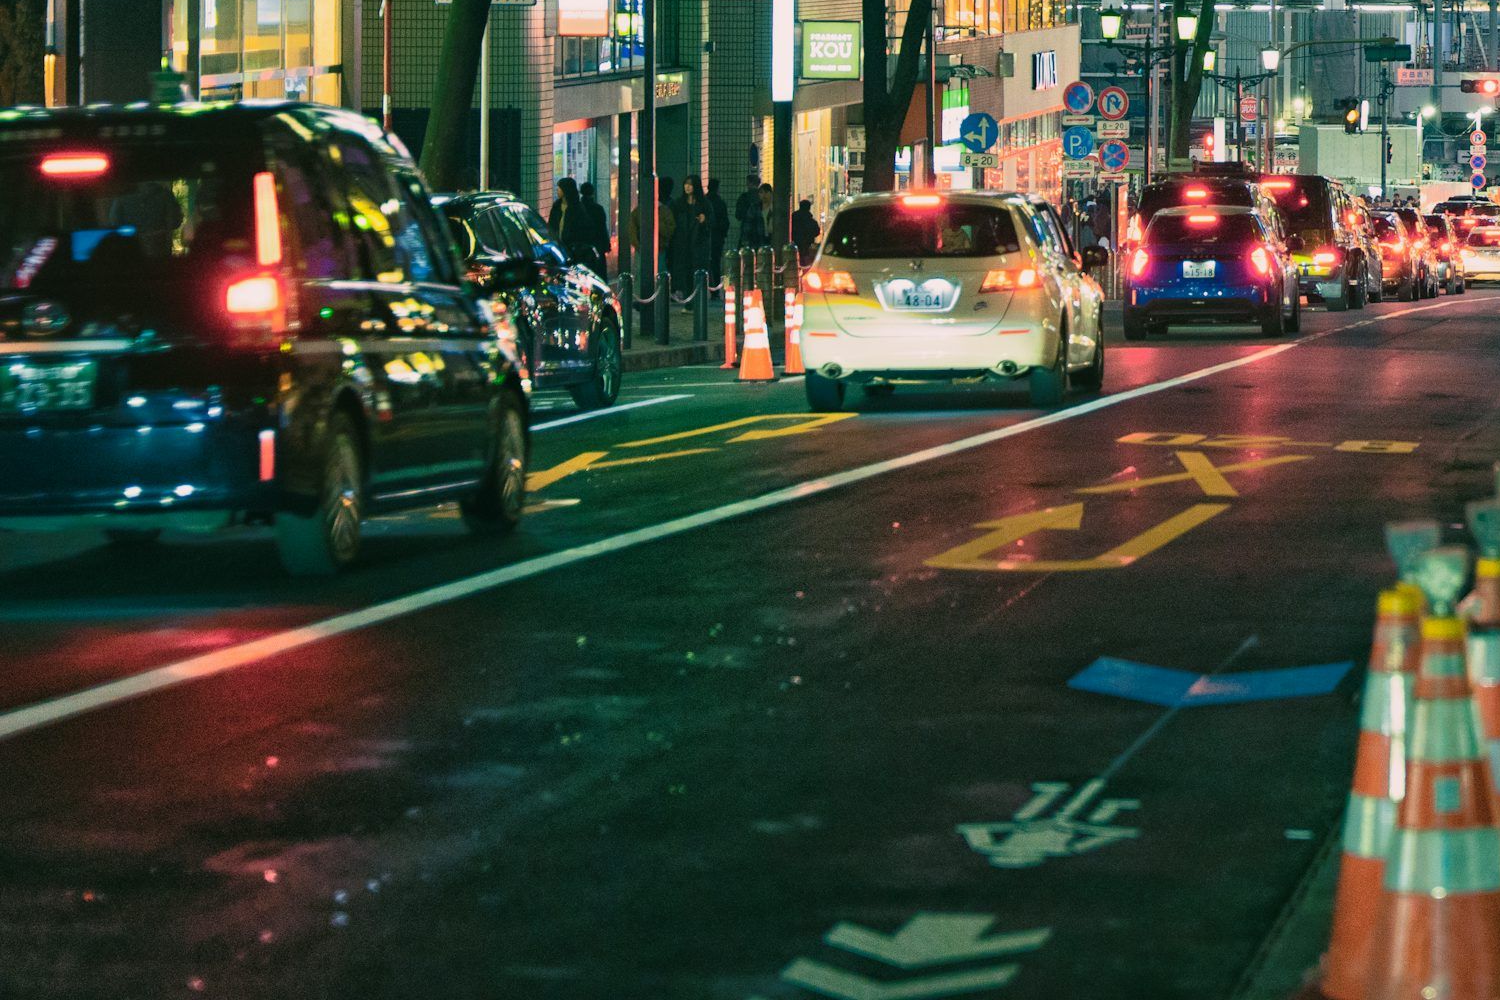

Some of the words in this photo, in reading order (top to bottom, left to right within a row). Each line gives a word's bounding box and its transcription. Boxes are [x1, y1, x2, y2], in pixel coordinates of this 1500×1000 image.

[810, 42, 853, 58] KOU
[1070, 135, 1082, 155] P
[965, 155, 993, 165] 8-20
[1190, 268, 1213, 277] 15-18
[905, 294, 940, 307] 48-04
